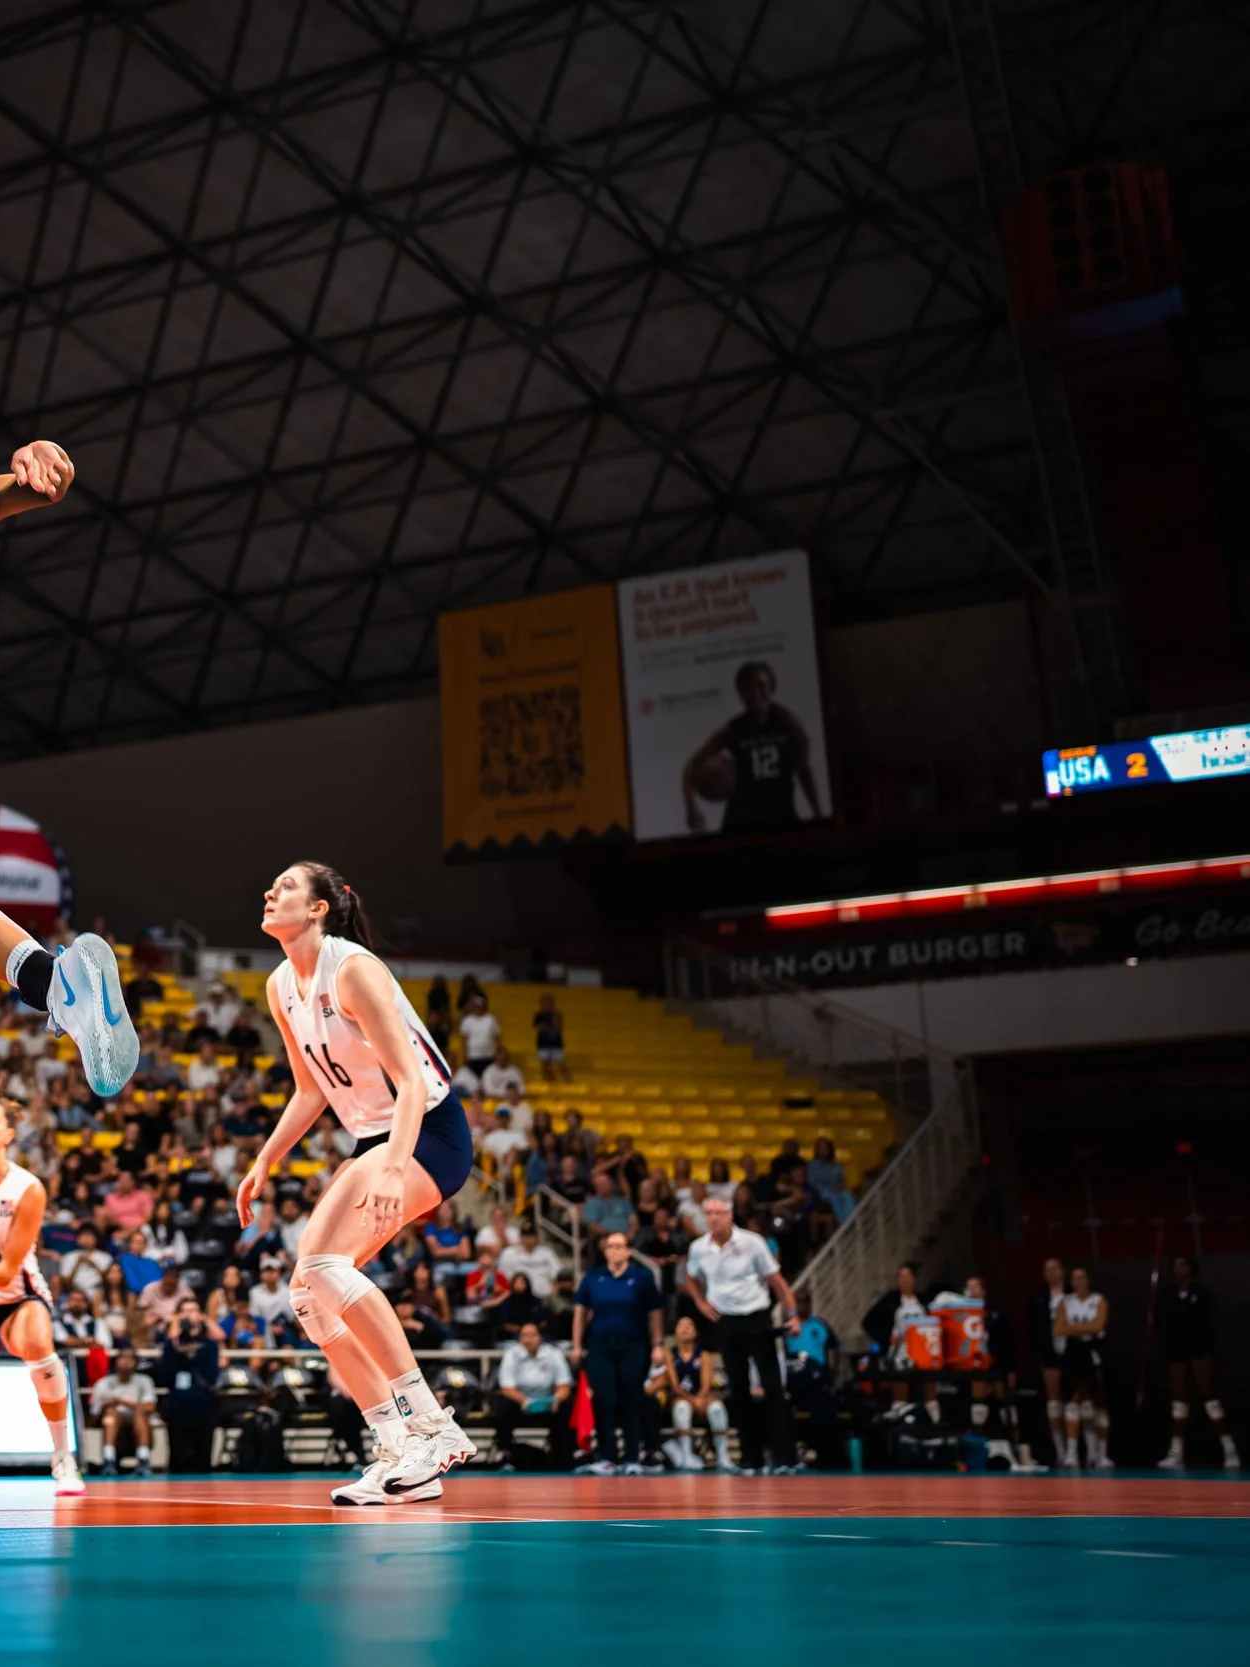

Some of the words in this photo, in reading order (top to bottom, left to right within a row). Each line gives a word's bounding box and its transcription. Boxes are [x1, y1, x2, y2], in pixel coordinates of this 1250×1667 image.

[751, 745, 782, 780] 12
[1059, 755, 1111, 787] USA
[1126, 752, 1148, 778] 2
[1135, 913, 1181, 947] Go
[888, 931, 1026, 967] BURGER
[322, 1007, 336, 1018] SA
[304, 1043, 353, 1088] 16
